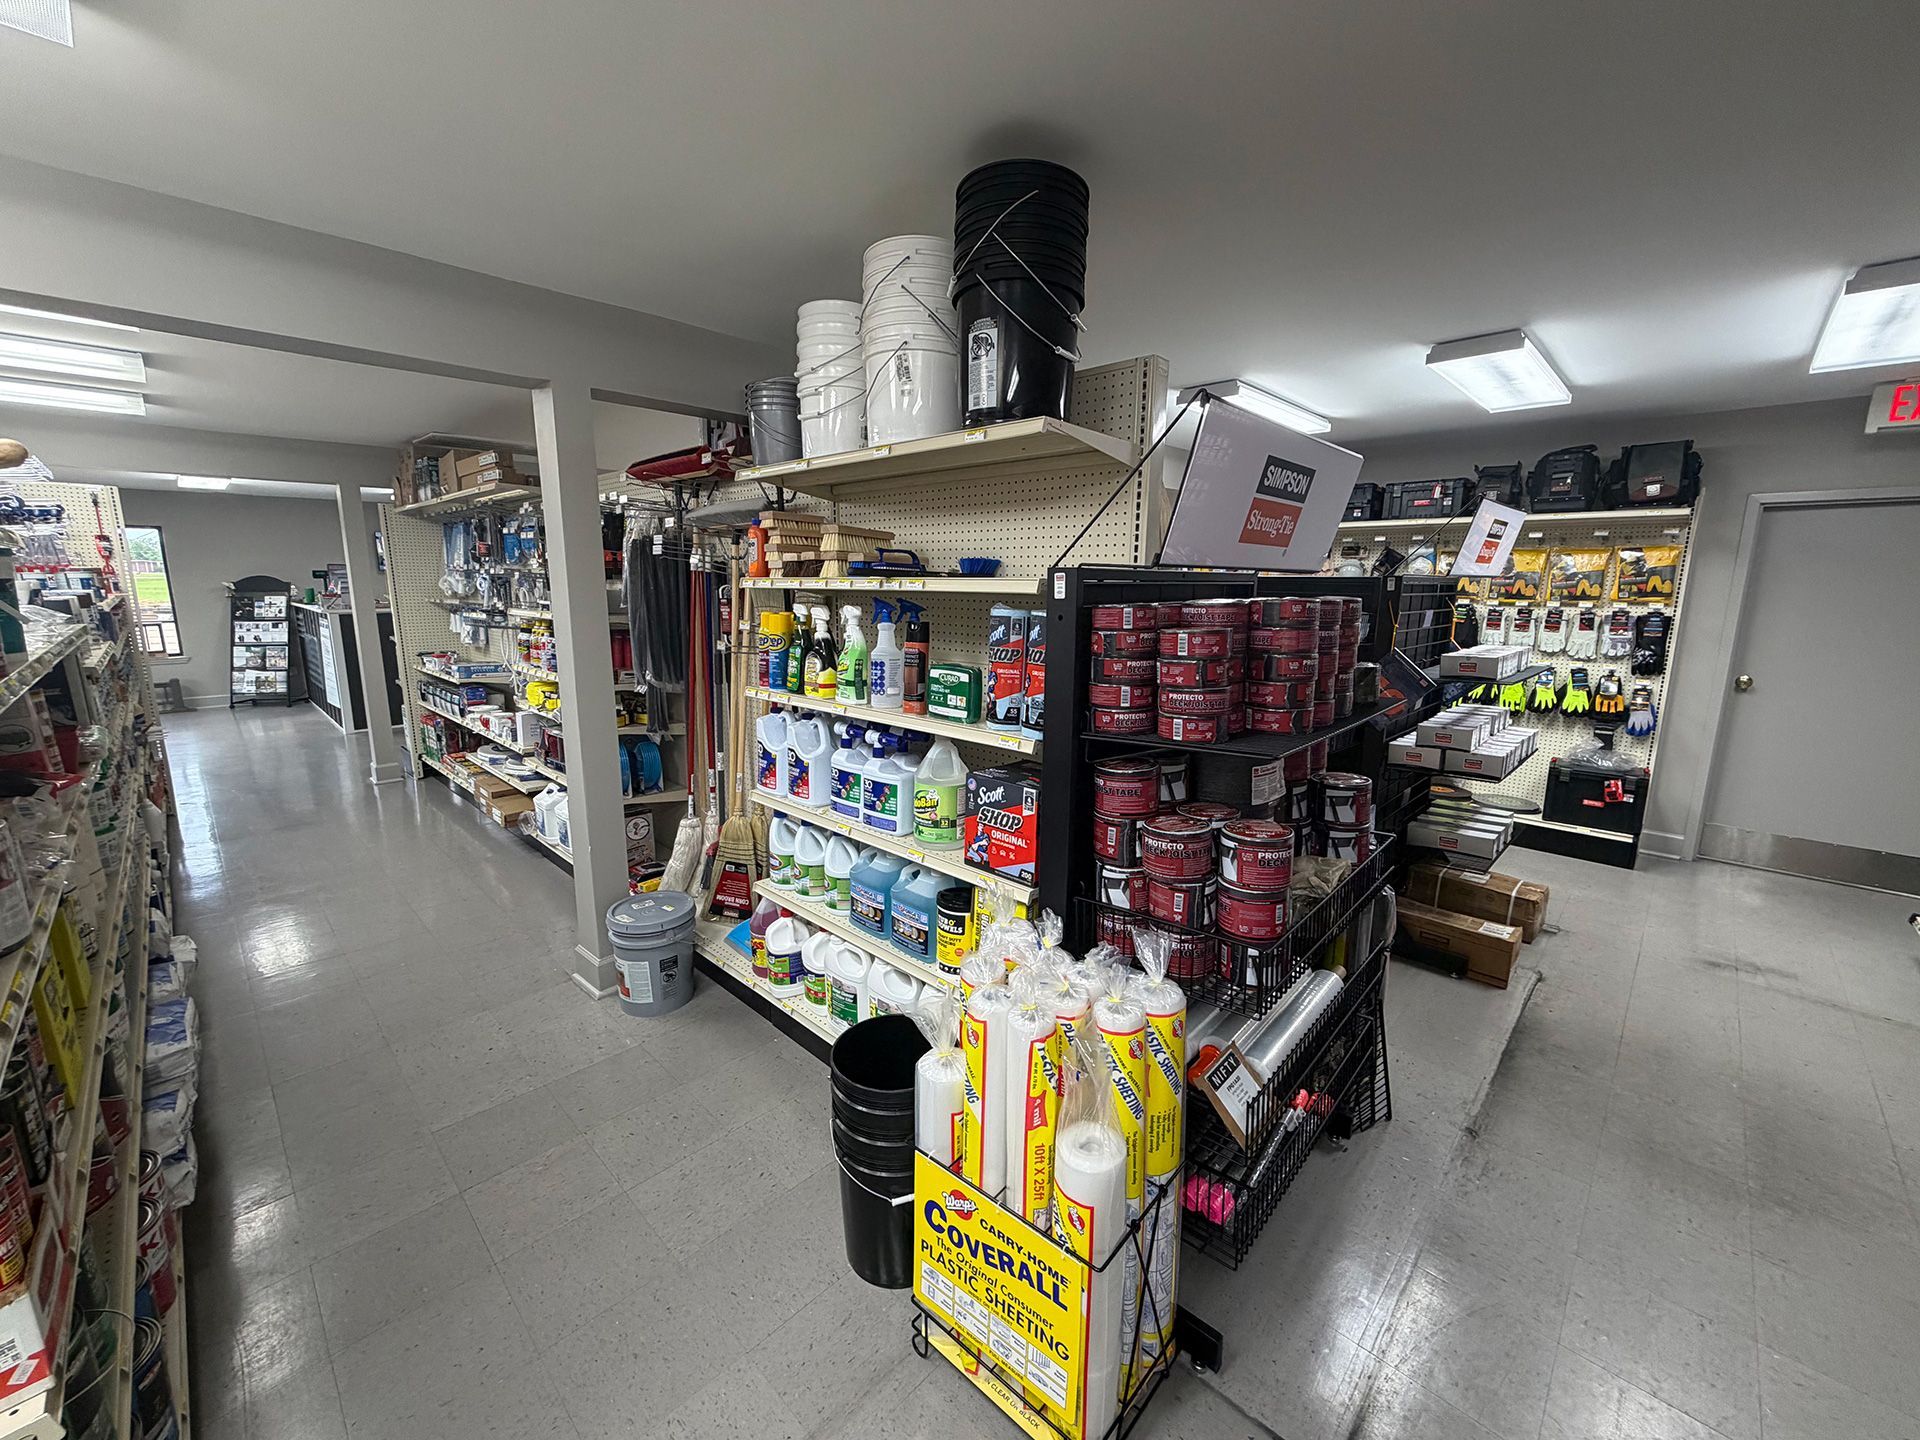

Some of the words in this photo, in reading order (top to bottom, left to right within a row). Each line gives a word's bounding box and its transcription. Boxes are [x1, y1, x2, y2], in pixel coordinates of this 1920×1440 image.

[1264, 464, 1310, 495] SIMPSON
[940, 673, 960, 682] CURAD
[1168, 693, 1204, 702] PROTECTO
[864, 779, 873, 789] 30
[977, 785, 1005, 805] Scott
[1115, 787, 1140, 796] TAPE
[978, 807, 1022, 831] SHOP
[991, 829, 1028, 848] ORIGINAL
[1144, 836, 1184, 850] PROTECTO
[1020, 870, 1032, 880] 200
[1146, 1018, 1167, 1058] LASTIC
[1157, 1056, 1183, 1096] SHEETING
[1211, 1056, 1237, 1087] NIFTY
[1112, 1076, 1145, 1120] SHEETING
[1034, 1142, 1046, 1167] 10ft
[1034, 1168, 1045, 1176] X
[1033, 1179, 1045, 1201] 25ft
[942, 1190, 979, 1214] Warp's
[924, 1199, 1068, 1312] COVERALL
[979, 1218, 1069, 1288] CARRY-HOME
[936, 1235, 952, 1255] The
[956, 1252, 997, 1288] Original
[1000, 1283, 1054, 1330] Consumer
[921, 1238, 979, 1293] PLASTIC
[985, 1287, 1070, 1361] SHEETING
[991, 1383, 1011, 1404] CLEAR
